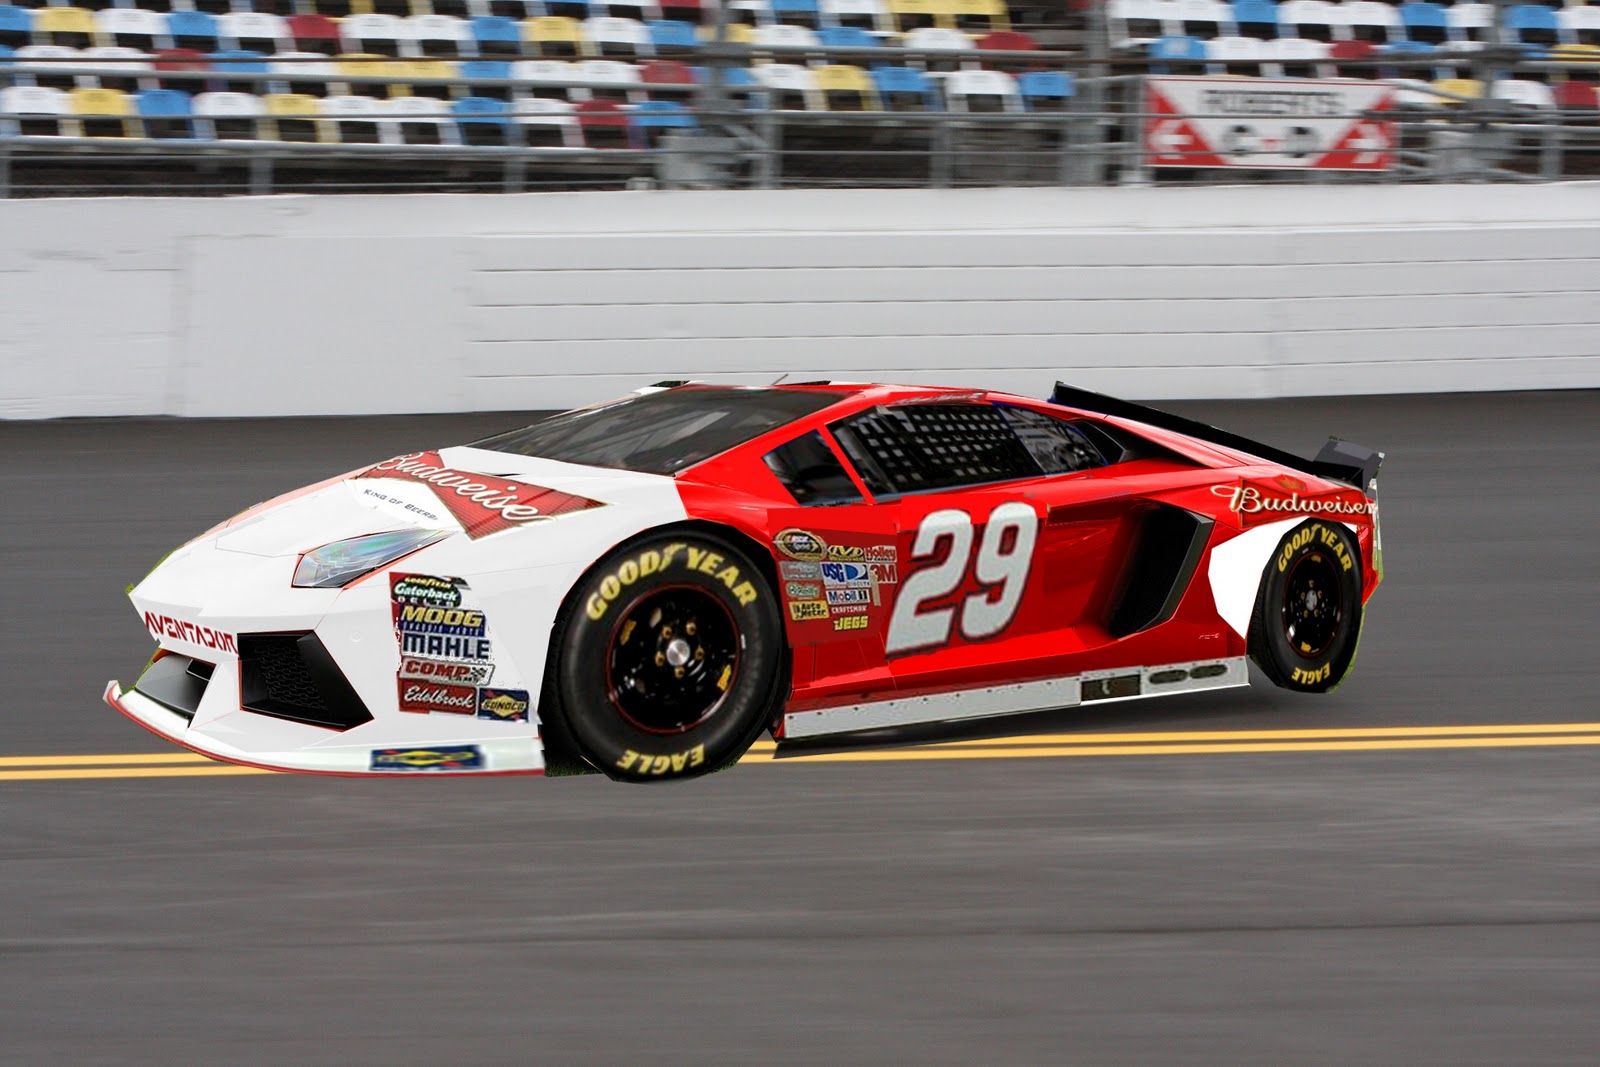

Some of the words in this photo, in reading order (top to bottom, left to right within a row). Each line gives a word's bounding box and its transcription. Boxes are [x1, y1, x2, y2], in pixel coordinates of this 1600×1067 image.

[363, 488, 387, 501] KING
[822, 563, 845, 583] USG
[885, 501, 1039, 656] 29
[394, 583, 457, 601] Gatorback
[828, 590, 857, 603] Mobil
[402, 606, 482, 627] MOOG
[834, 616, 868, 630] JEGS
[403, 633, 489, 659] MAHLE
[405, 660, 470, 678] COMP
[1291, 662, 1331, 685] EAGLE
[404, 686, 475, 708] Edelbrock
[616, 744, 705, 775] EAGLE
